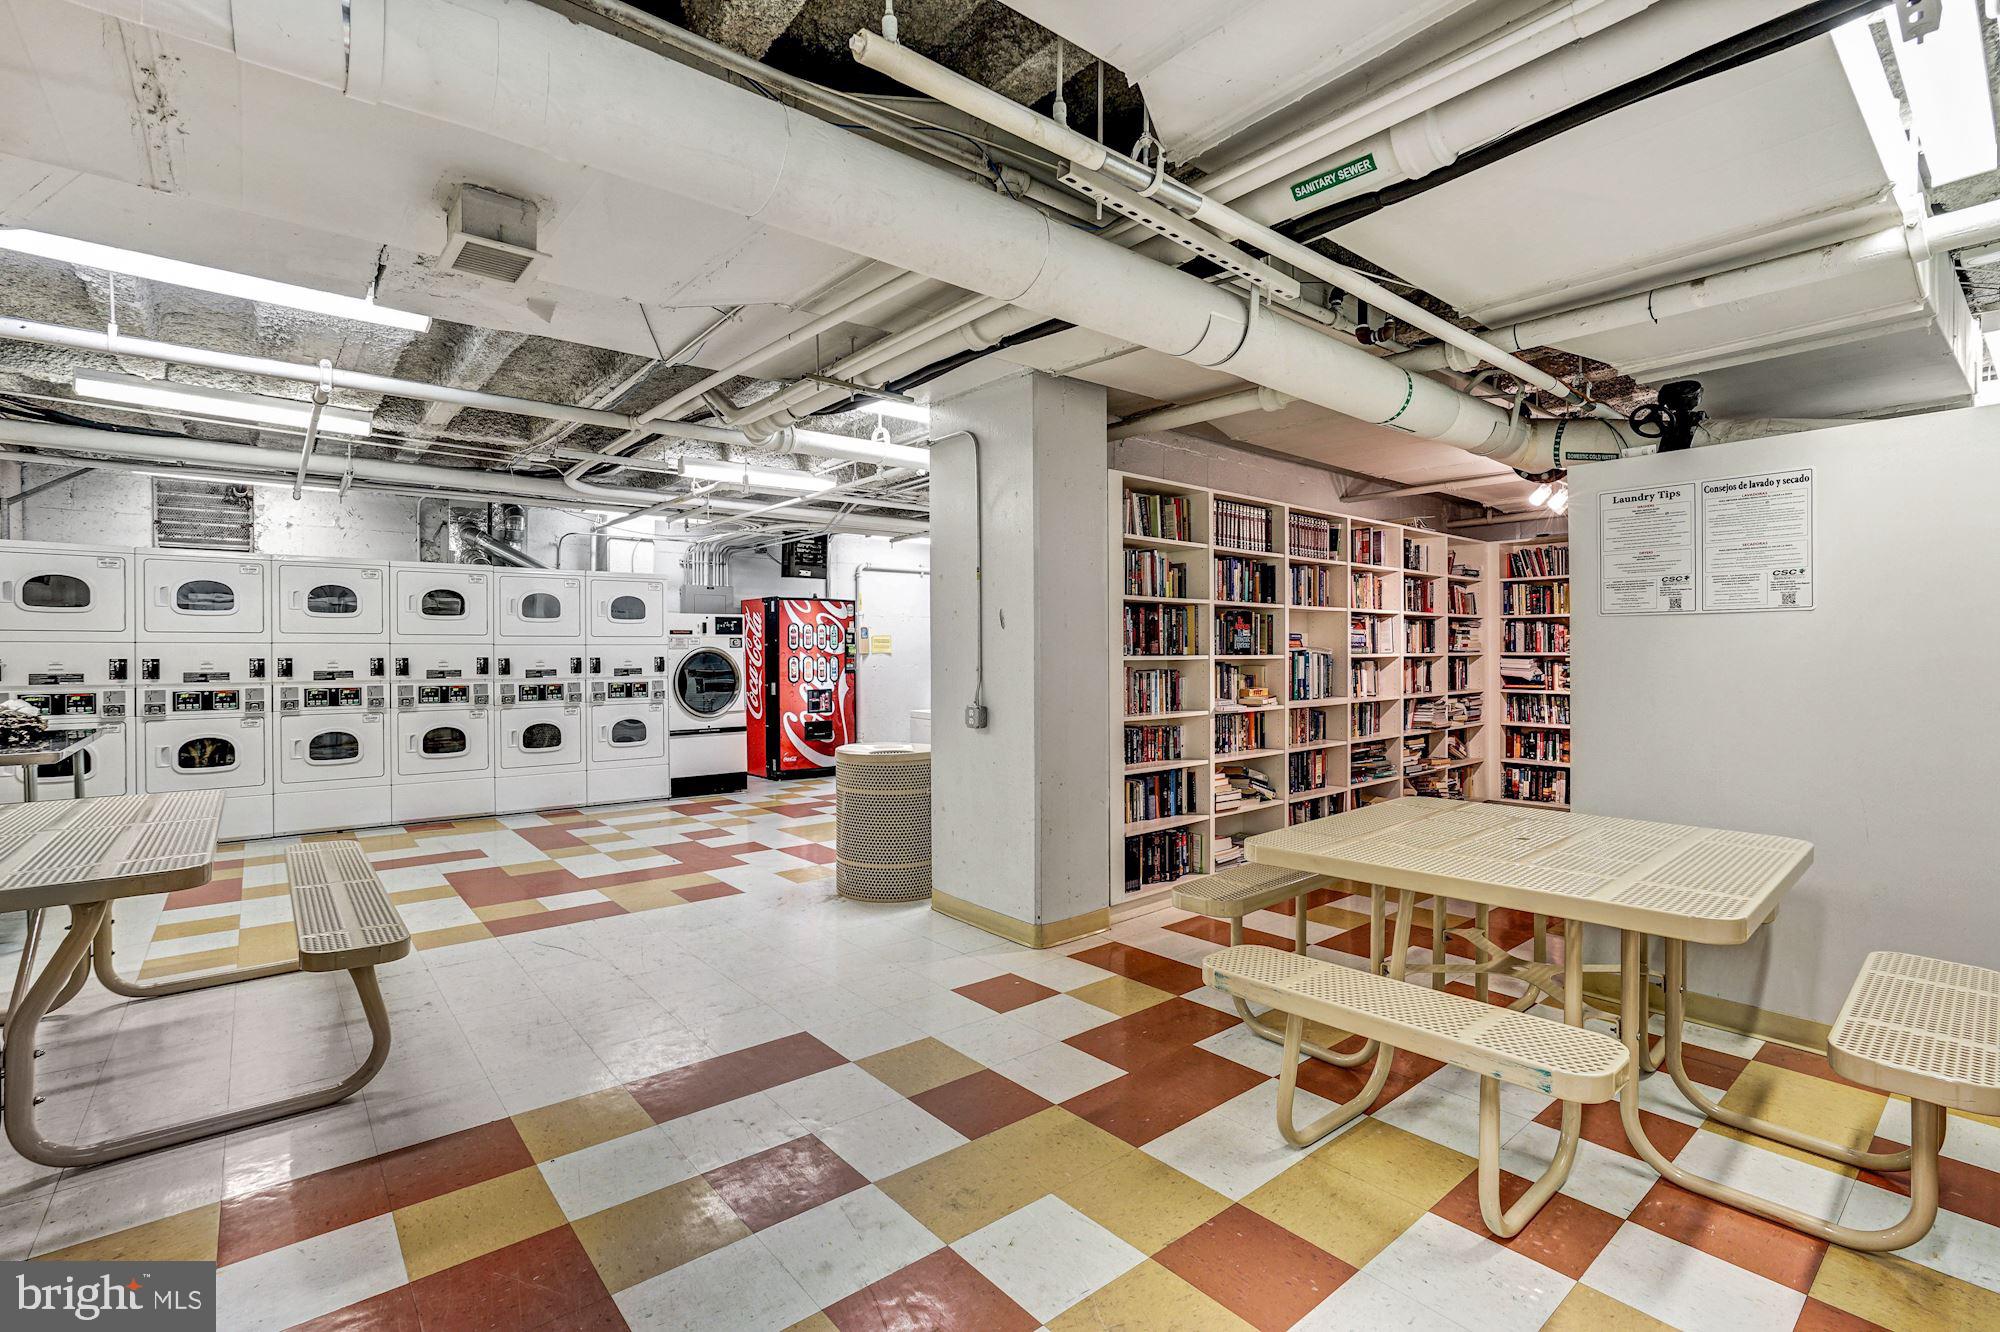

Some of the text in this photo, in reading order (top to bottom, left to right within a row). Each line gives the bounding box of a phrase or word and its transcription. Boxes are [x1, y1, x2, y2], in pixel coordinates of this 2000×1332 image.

[1294, 159, 1372, 197] SANITARY SEWER
[1703, 474, 1810, 494] Consejos de lavado y secado
[1612, 490, 1681, 504] Laundry Tips
[1661, 575, 1683, 583] CSC
